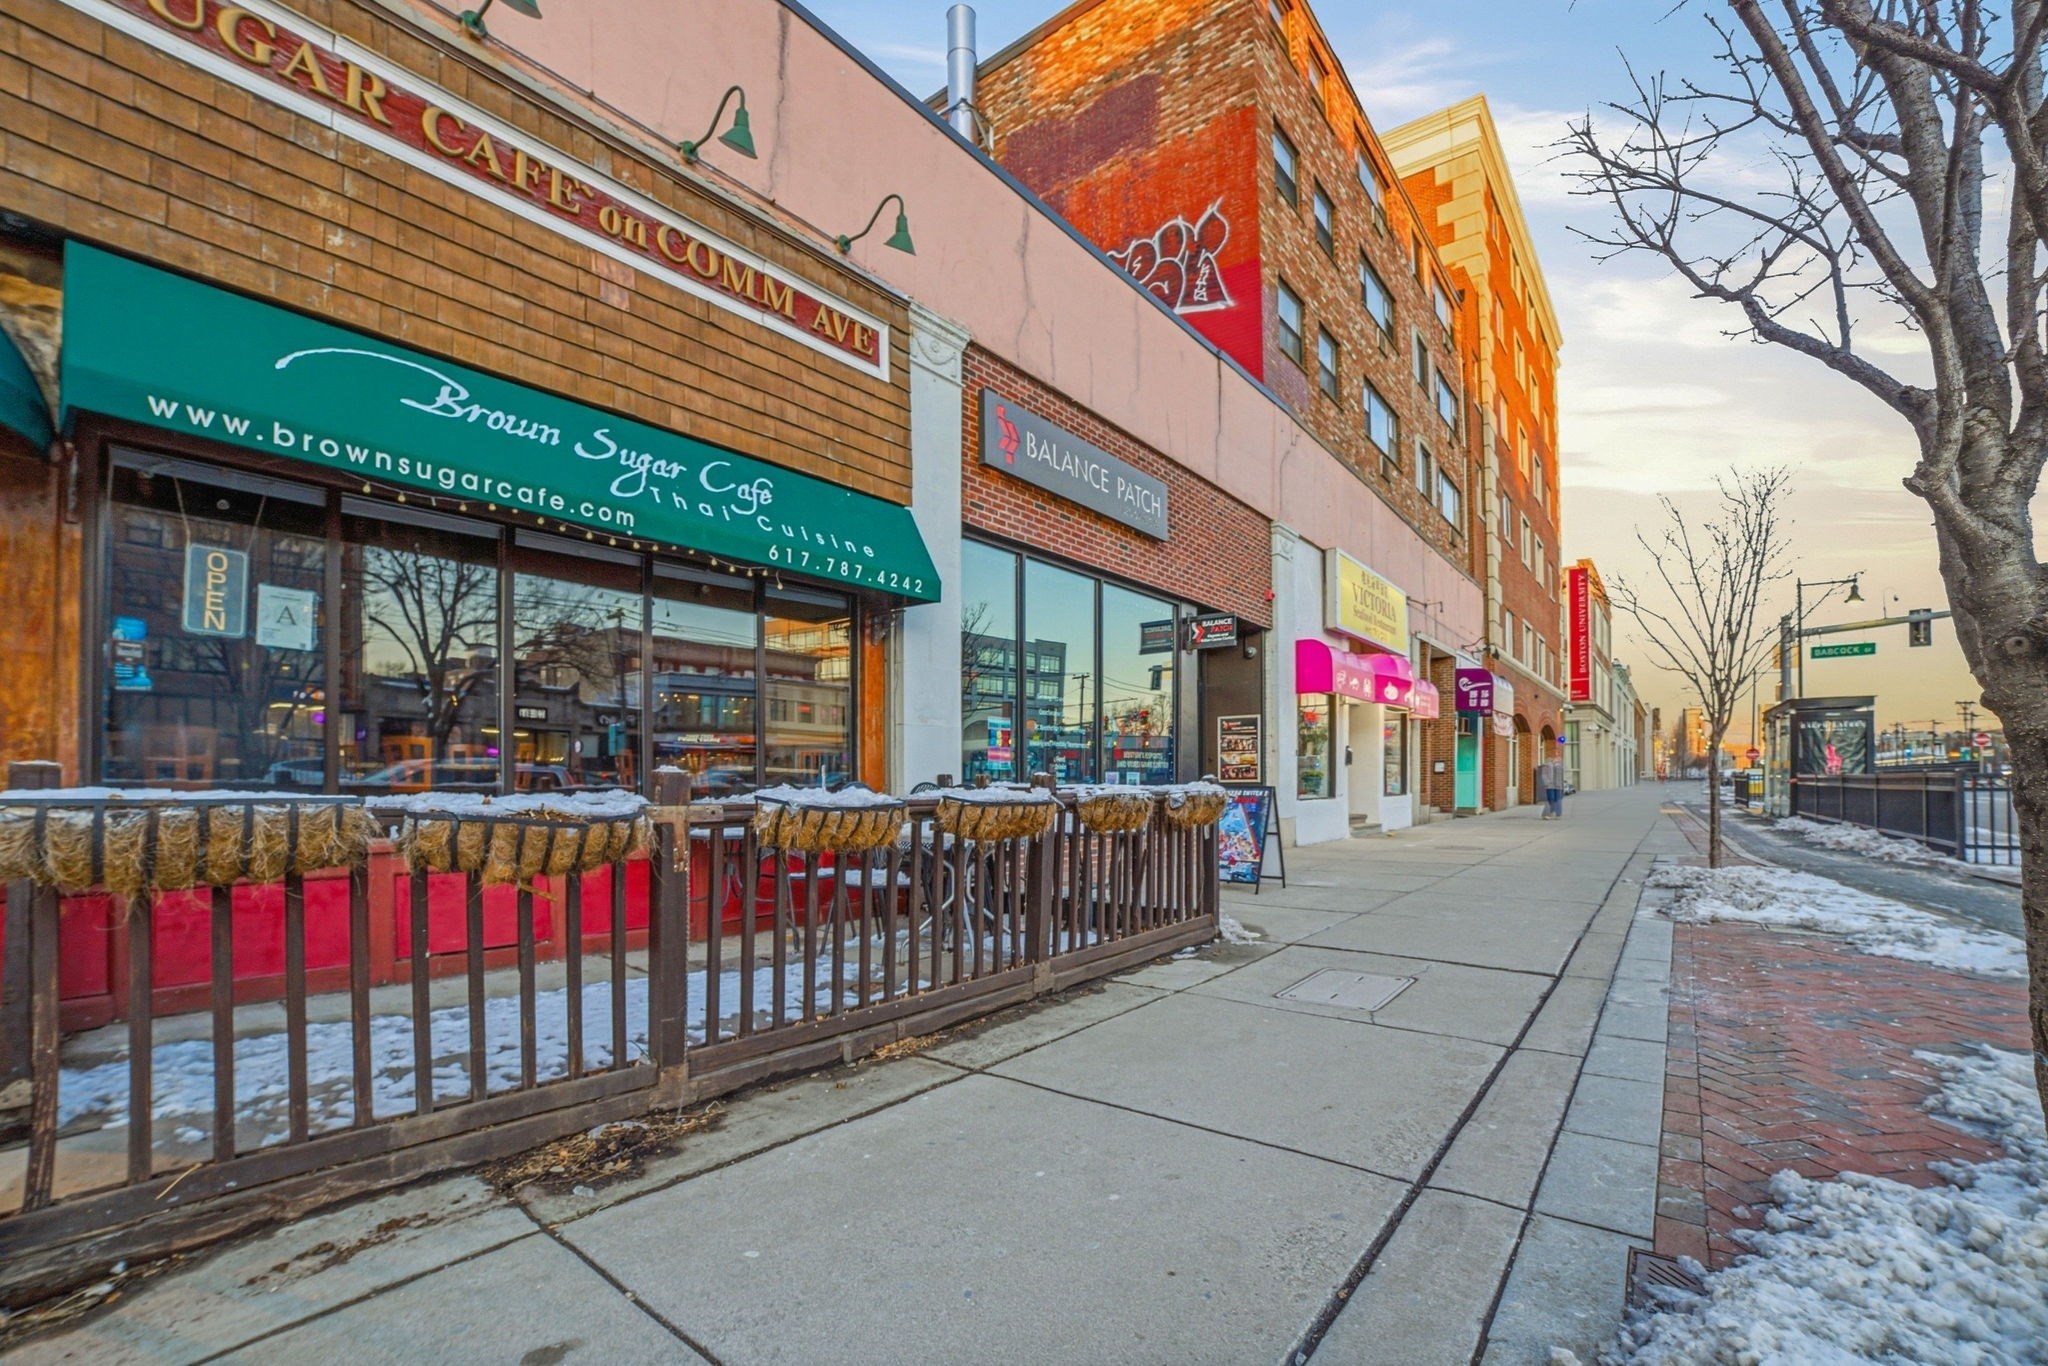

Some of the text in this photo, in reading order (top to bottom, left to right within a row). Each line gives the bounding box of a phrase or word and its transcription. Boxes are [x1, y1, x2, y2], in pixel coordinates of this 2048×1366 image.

[599, 206, 649, 250] on
[656, 224, 796, 320] COMM
[810, 304, 874, 357] AVE
[146, 395, 636, 528] www.brownsugarcafe.com
[574, 428, 687, 498] Sugar
[1026, 431, 1162, 518] BALANCE PATCH
[650, 486, 875, 558] Thai Cuisine
[203, 552, 228, 631] OPEN
[768, 545, 923, 593] 617.787.4242
[1352, 582, 1397, 623] VICTORIA
[276, 605, 298, 626] A
[1578, 574, 1587, 673] BOSTON UNIVERSITY
[1814, 646, 1860, 656] BABCOCK
